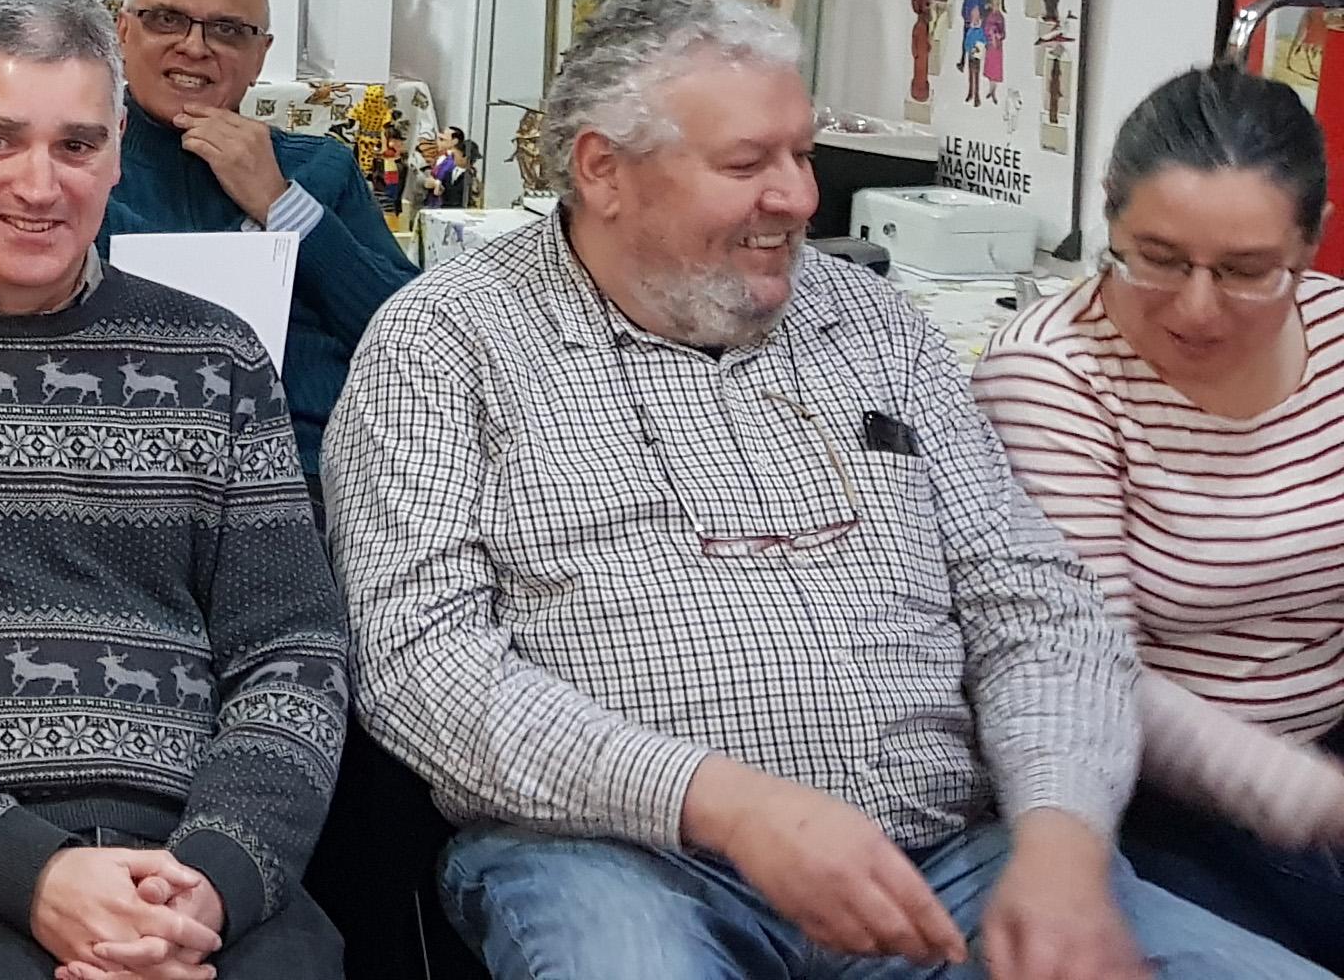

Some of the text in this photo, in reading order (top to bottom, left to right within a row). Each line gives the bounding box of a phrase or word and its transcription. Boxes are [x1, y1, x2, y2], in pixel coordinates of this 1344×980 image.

[946, 135, 1022, 170] LE MUSÉE
[938, 154, 1033, 195] MAGINAIRE
[967, 181, 1023, 206] TINTIN
